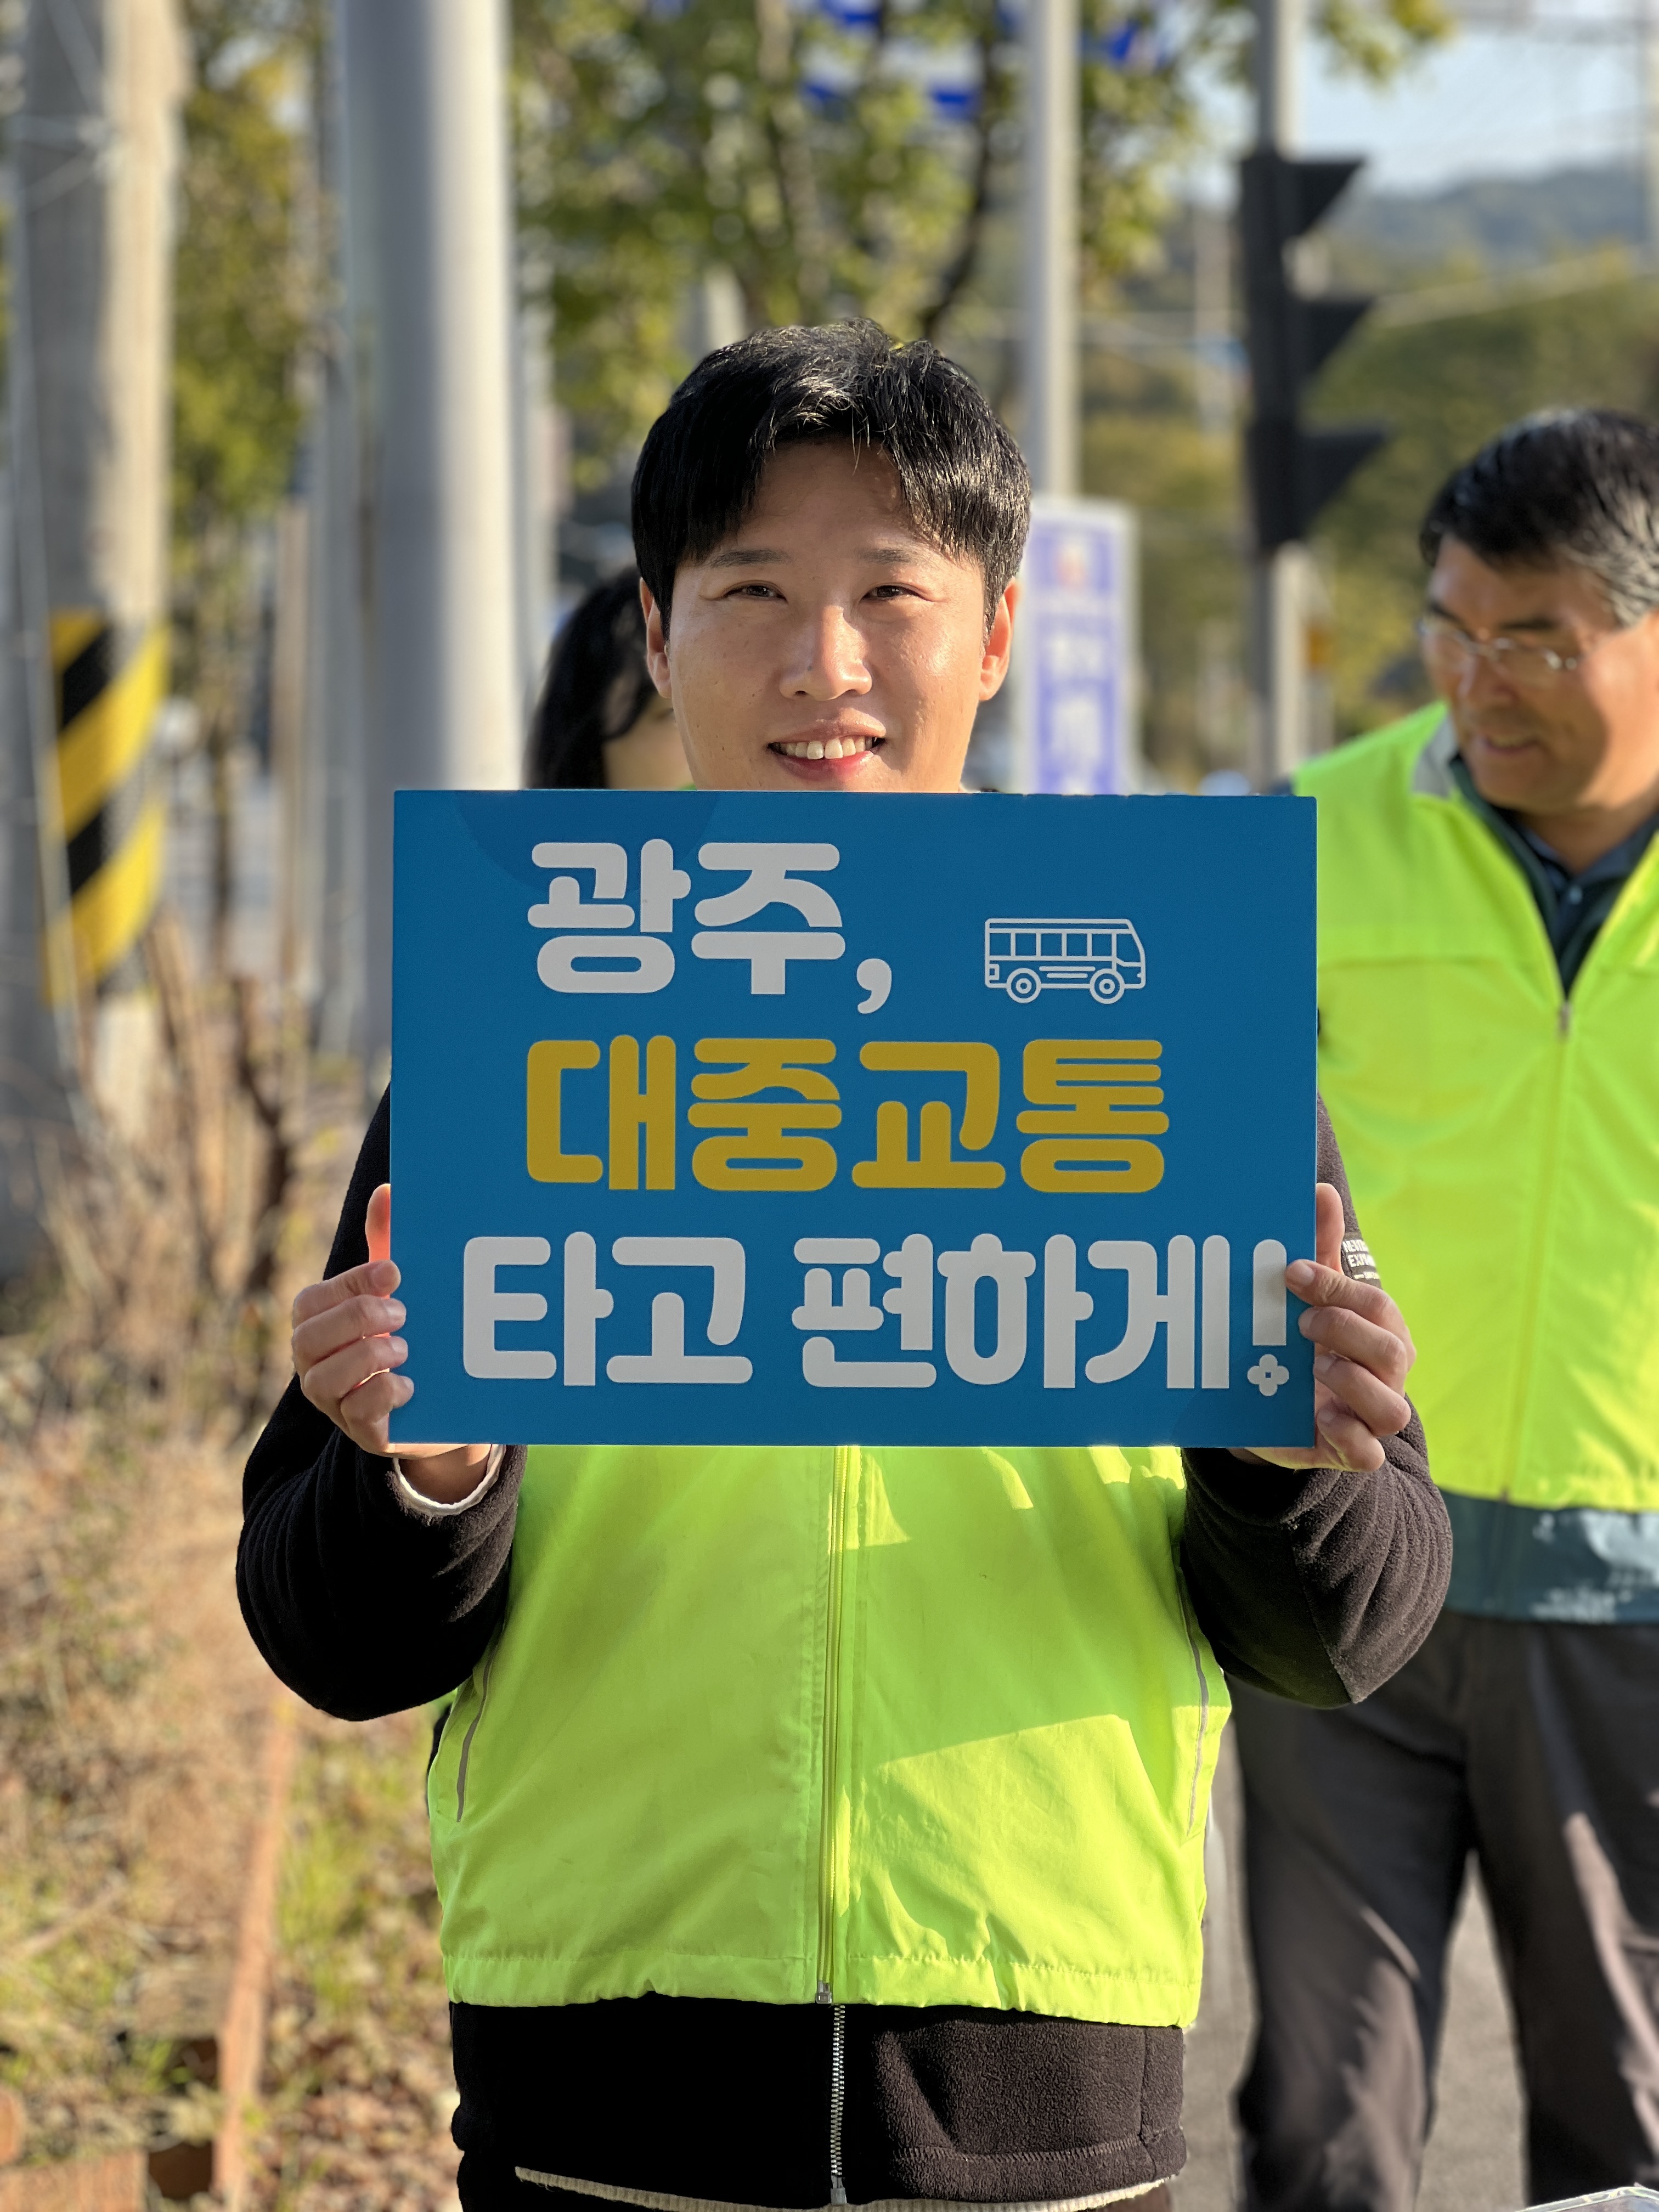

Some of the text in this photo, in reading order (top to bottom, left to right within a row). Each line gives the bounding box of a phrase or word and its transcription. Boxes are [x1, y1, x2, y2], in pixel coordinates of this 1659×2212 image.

[527, 838, 893, 1014] 광주,
[526, 1034, 1170, 1193] 대중교통
[462, 1231, 1290, 1397] 타고 편하게!
